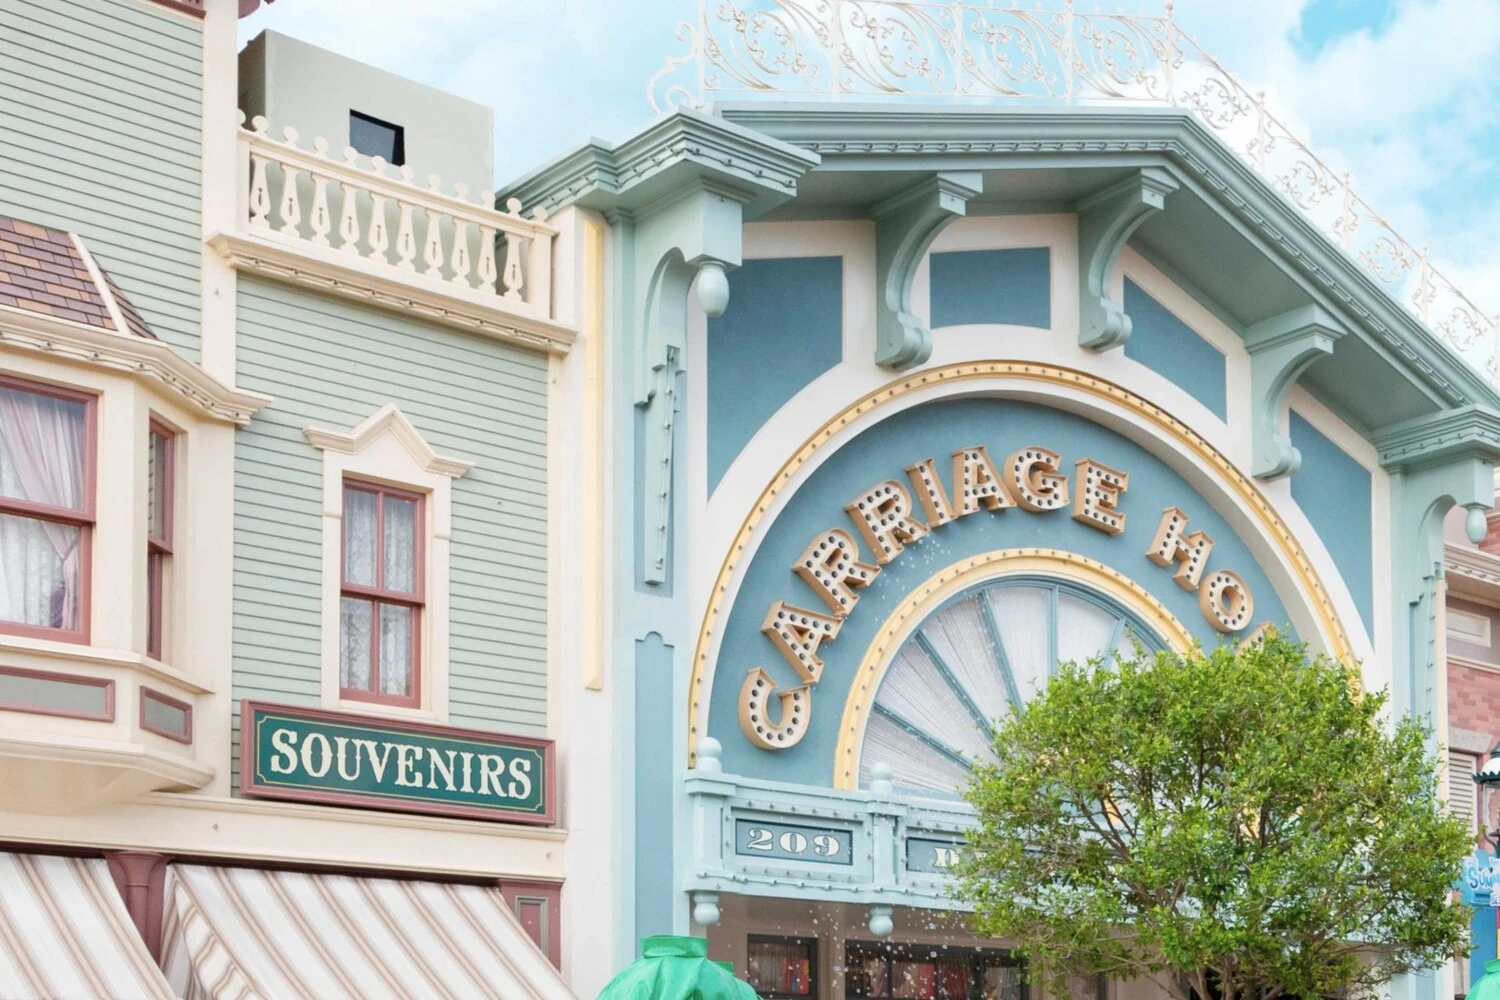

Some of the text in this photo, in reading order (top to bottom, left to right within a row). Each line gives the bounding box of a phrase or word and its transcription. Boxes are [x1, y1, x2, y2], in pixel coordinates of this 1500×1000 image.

[738, 446, 1129, 751] CARRIAGE
[270, 728, 532, 800] SOUVENIRS
[748, 828, 840, 857] 209
